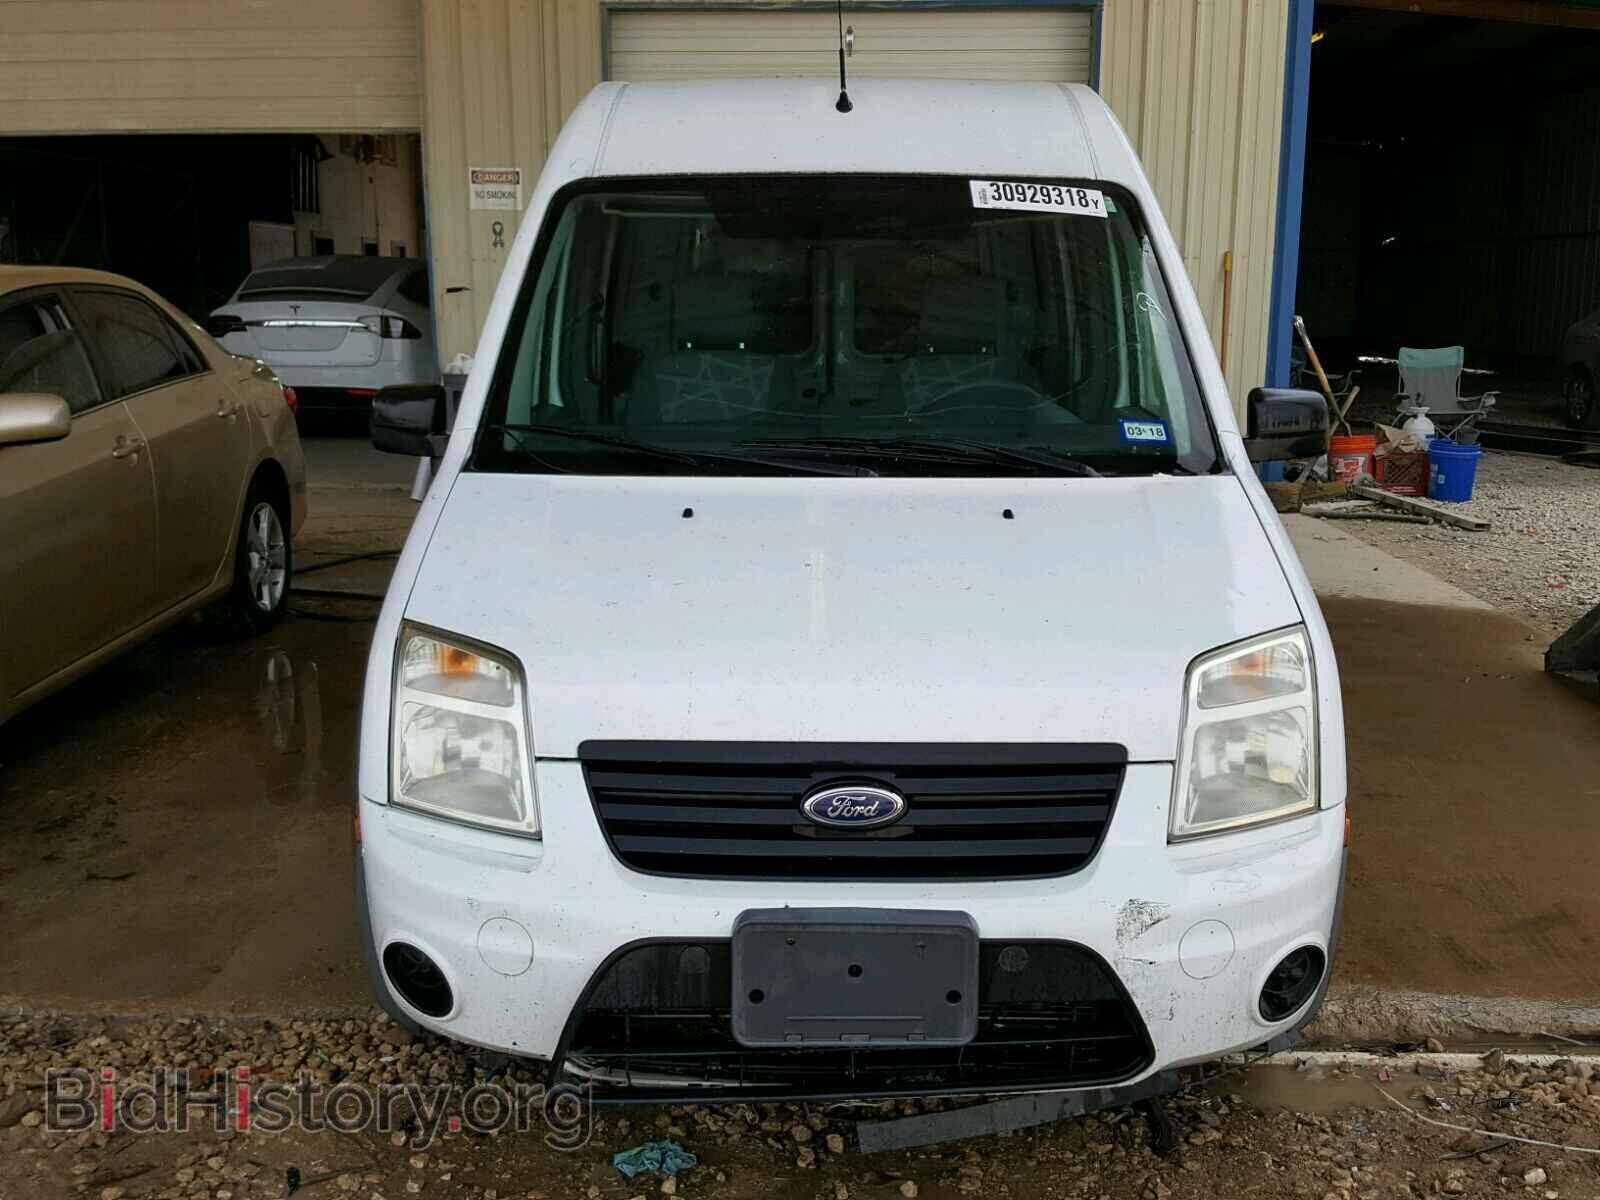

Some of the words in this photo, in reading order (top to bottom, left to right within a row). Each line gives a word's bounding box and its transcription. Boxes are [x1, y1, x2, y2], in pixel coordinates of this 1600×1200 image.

[478, 174, 515, 183] DANGER
[475, 190, 485, 199] NO
[990, 183, 1089, 208] 30929318
[1090, 199, 1099, 209] Y
[827, 795, 880, 817] Ford
